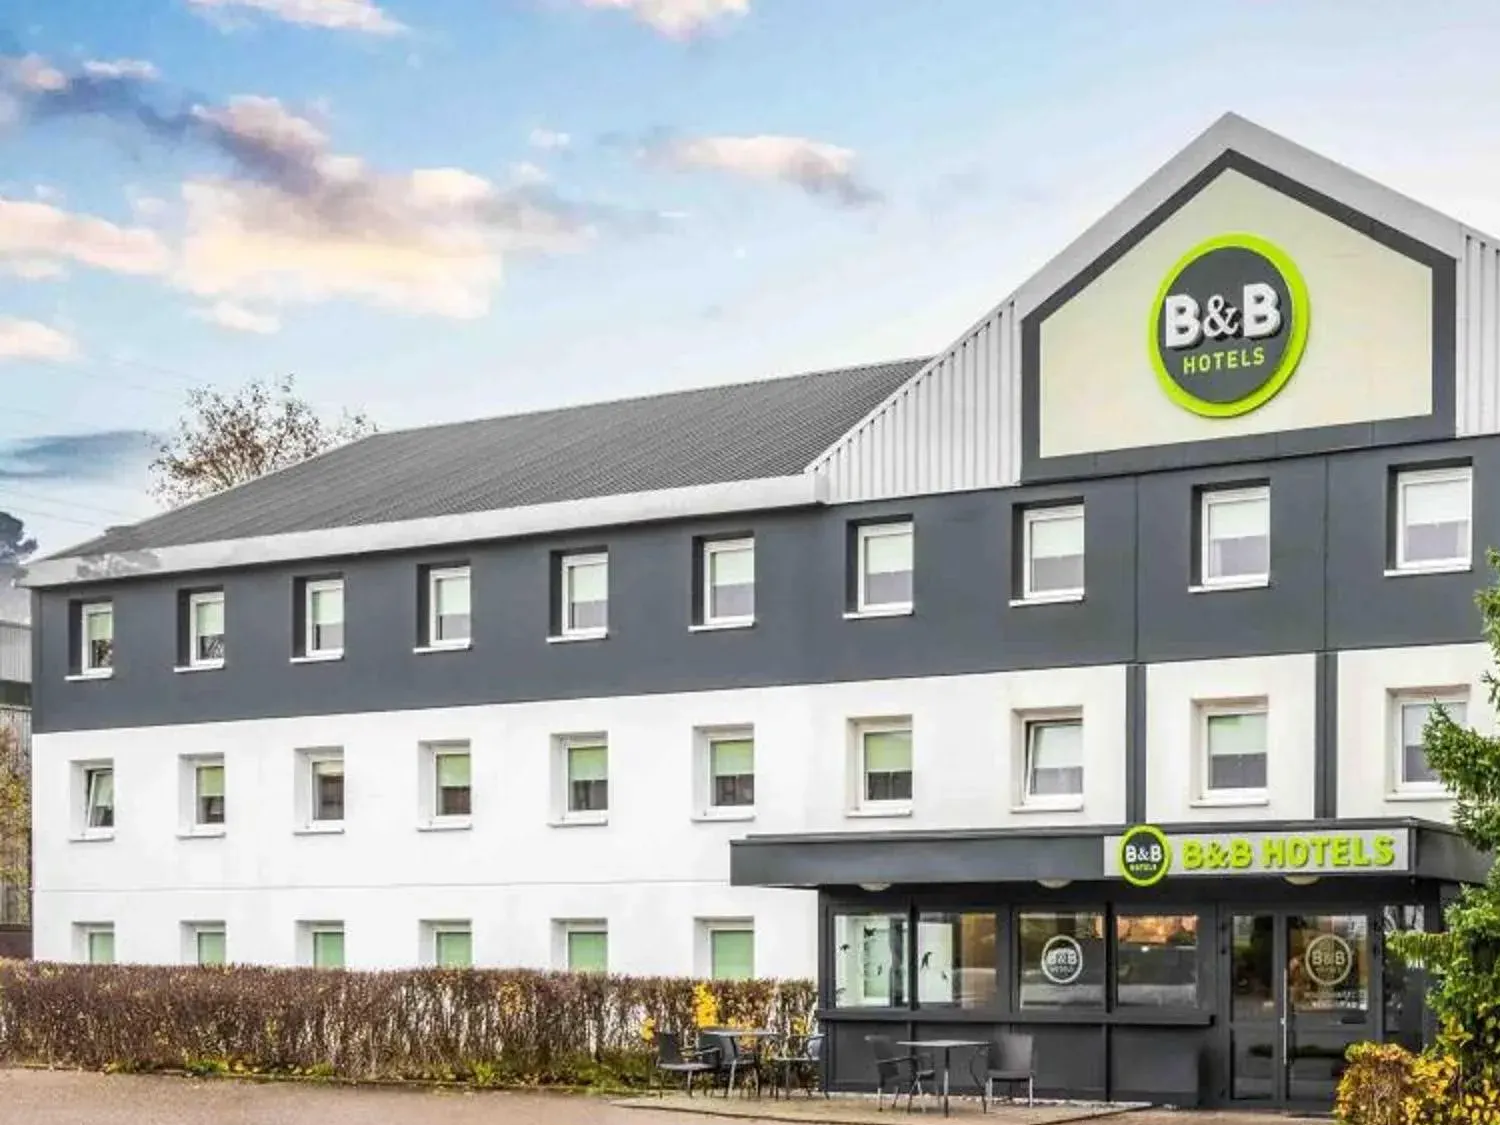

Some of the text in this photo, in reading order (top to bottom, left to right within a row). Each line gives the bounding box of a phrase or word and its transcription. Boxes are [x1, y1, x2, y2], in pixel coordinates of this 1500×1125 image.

[1165, 282, 1282, 348] B&B
[1183, 347, 1265, 374] HOTELS
[1126, 844, 1162, 862] B&B
[1183, 835, 1397, 869] B&B HOTELS
